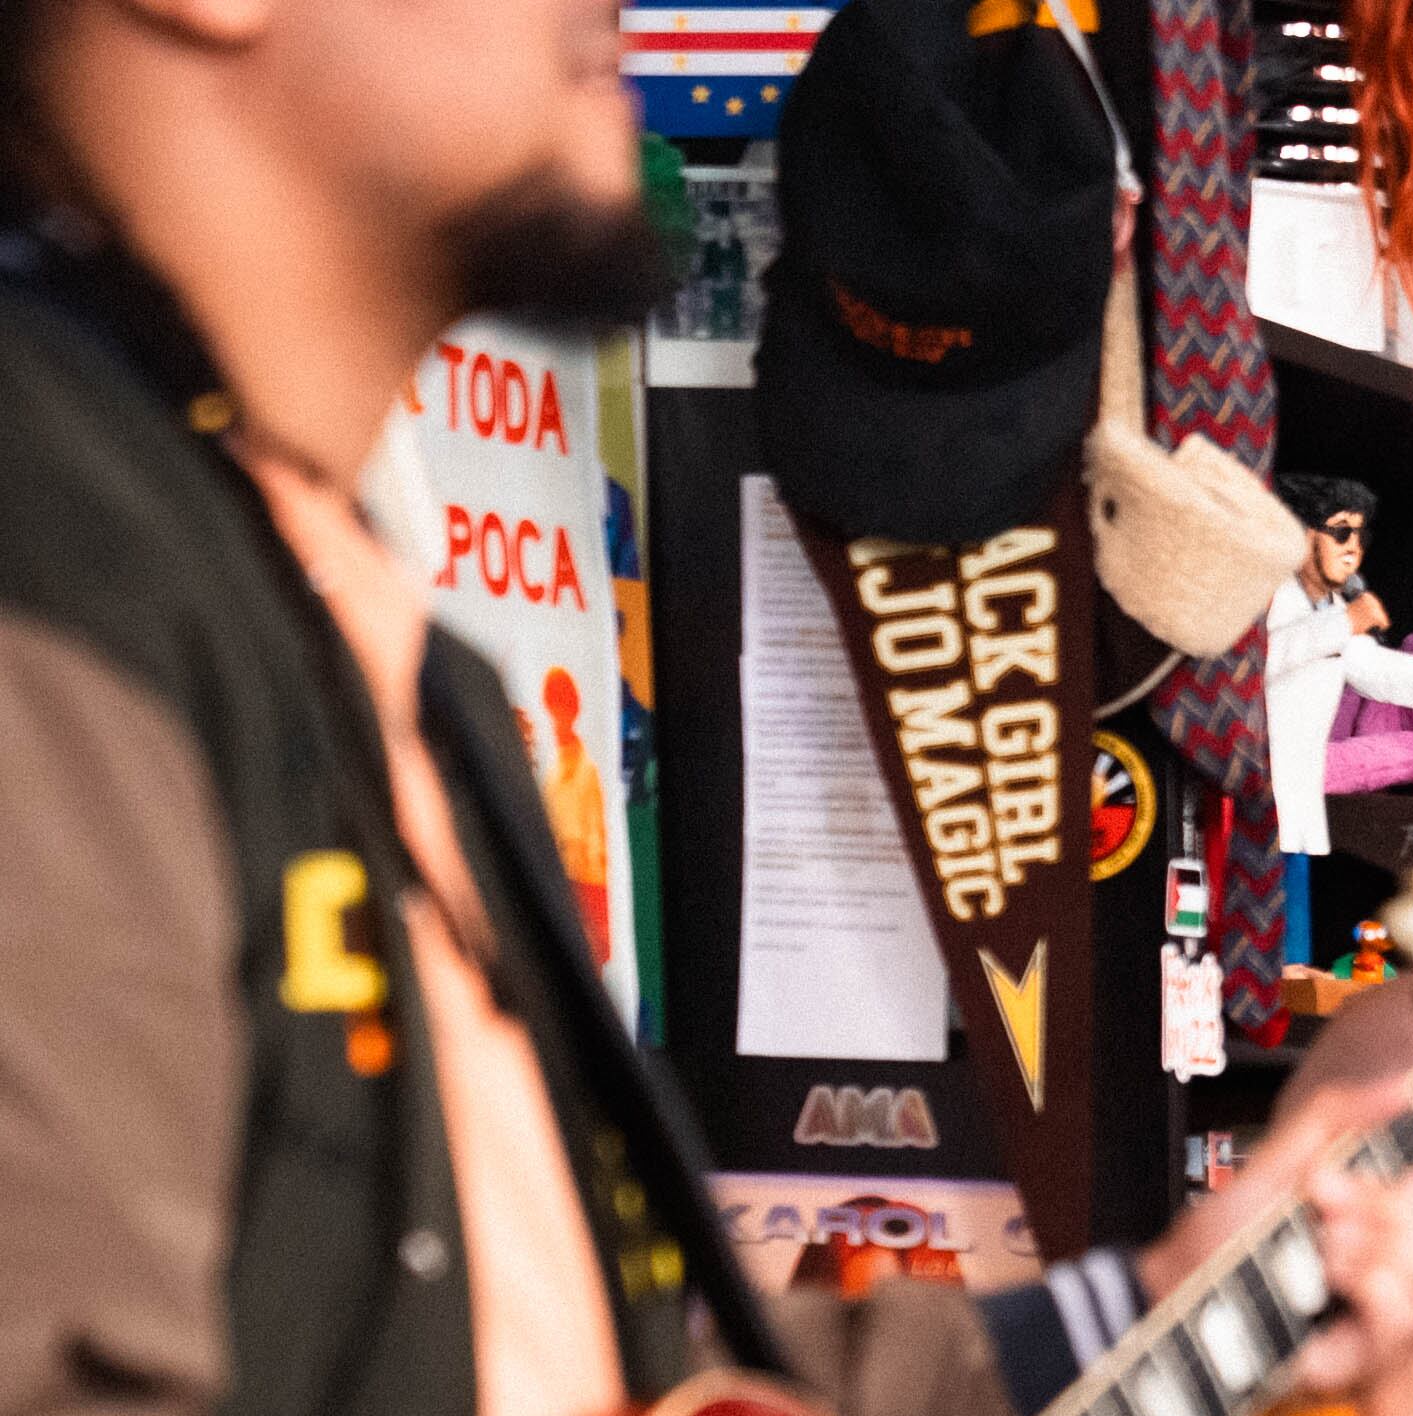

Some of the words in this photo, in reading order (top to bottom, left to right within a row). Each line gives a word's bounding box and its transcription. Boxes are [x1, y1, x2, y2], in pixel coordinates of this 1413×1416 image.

[439, 343, 569, 457] TODA
[434, 503, 588, 613] POCA
[888, 679, 1007, 922] MAGIC
[980, 699, 1060, 886] GIRL
